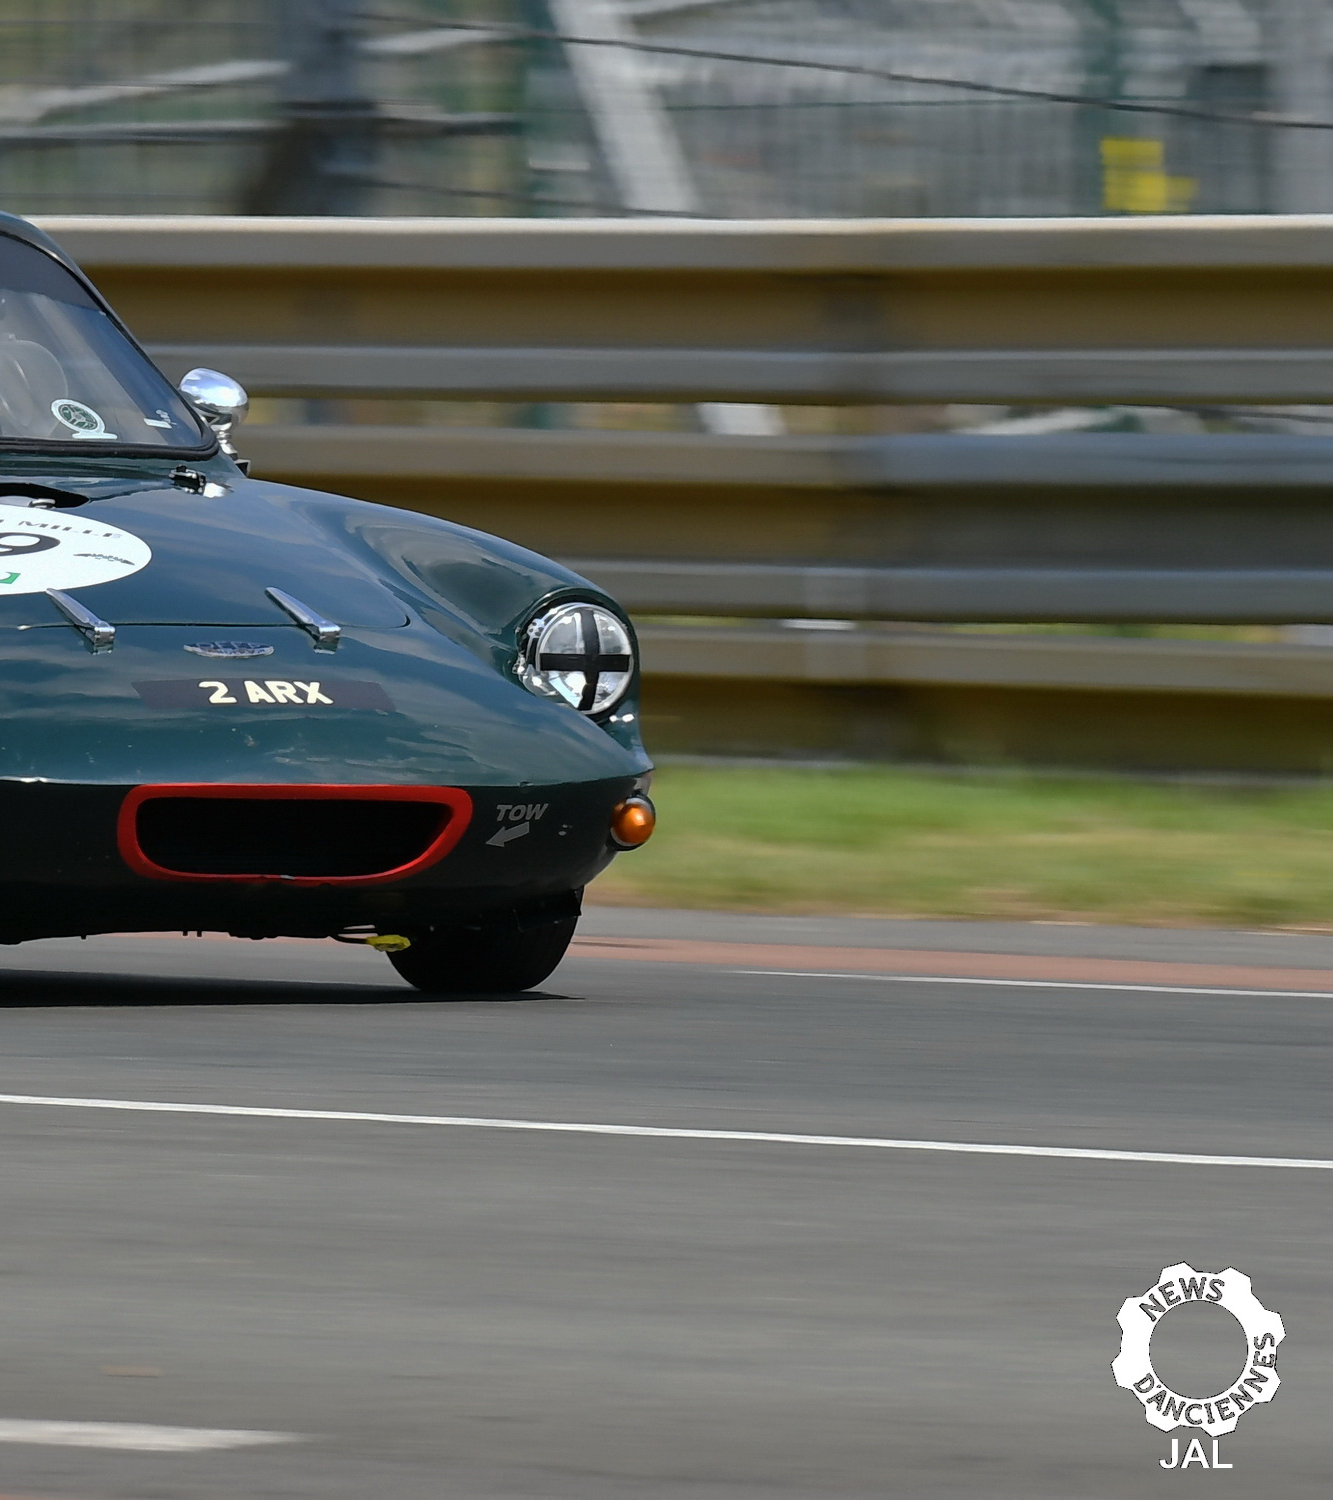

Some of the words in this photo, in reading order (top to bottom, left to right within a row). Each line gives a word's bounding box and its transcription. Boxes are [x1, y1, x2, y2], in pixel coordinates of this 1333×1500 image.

[17, 520, 123, 539] MILLE
[198, 681, 237, 704] 2
[244, 681, 333, 704] ARX
[496, 804, 548, 822] TOW
